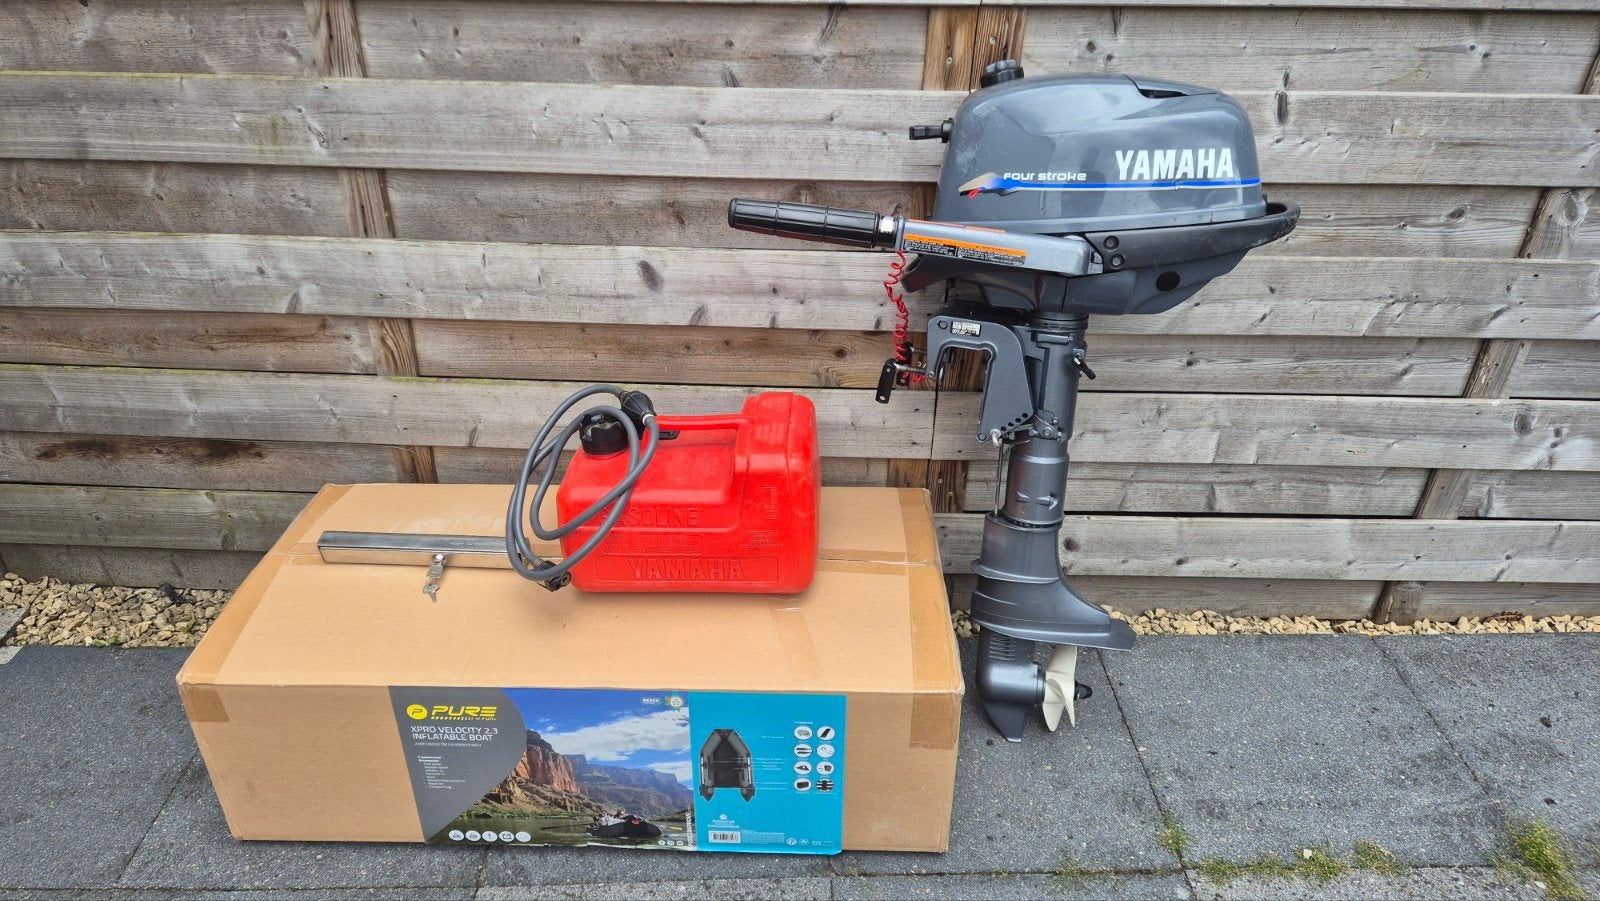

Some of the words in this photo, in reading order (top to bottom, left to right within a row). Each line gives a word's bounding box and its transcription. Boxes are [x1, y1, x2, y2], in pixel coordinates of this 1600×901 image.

[1115, 148, 1234, 180] YAMAHA
[628, 558, 744, 580] YAMAHA
[431, 705, 498, 717] PURE
[410, 725, 436, 733] XPRO
[438, 726, 482, 735] VELOCITY
[484, 727, 499, 735] 2.3
[412, 733, 467, 741] INFLATABLE
[469, 734, 493, 742] BOAT
